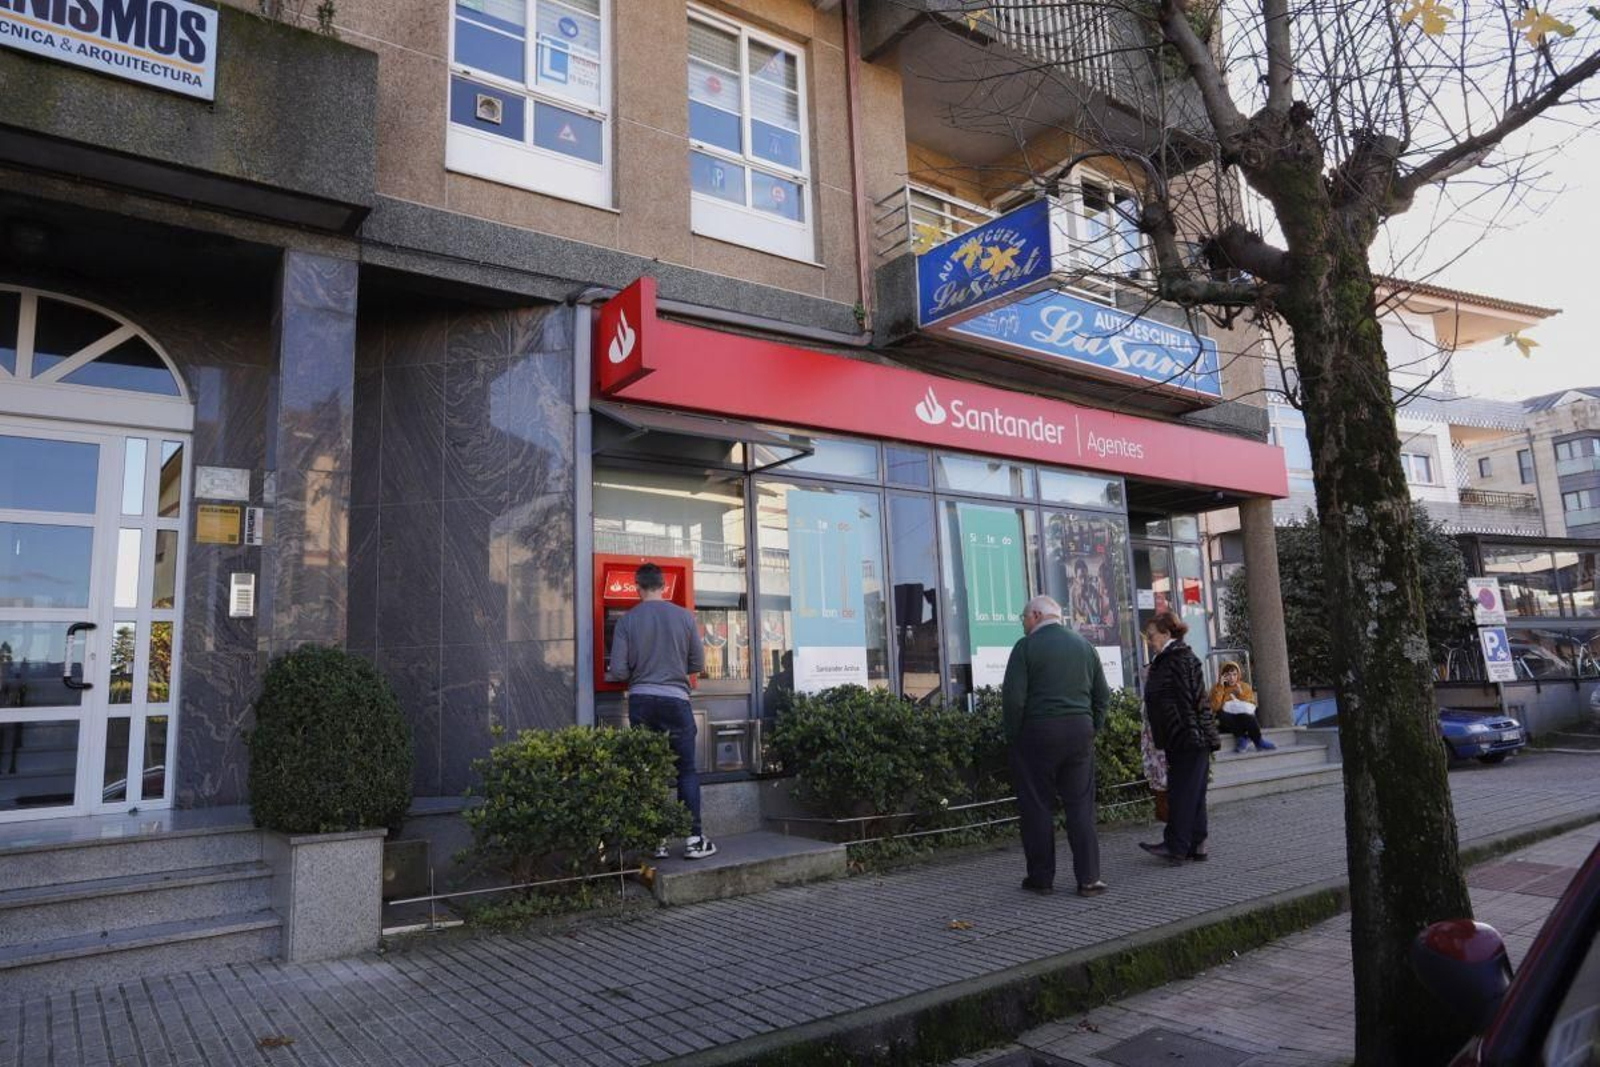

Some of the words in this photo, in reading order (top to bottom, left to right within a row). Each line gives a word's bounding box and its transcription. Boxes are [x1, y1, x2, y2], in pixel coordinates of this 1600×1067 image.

[0, 0, 206, 64] SMOS
[60, 38, 72, 52] &
[77, 43, 202, 87] ARQUITECTURA
[939, 228, 1026, 281] AUESCUELA
[1095, 312, 1193, 354] AUTOESCUELA
[951, 400, 1064, 444] Santander
[1088, 431, 1143, 459] Agentes
[1484, 631, 1499, 656] P
